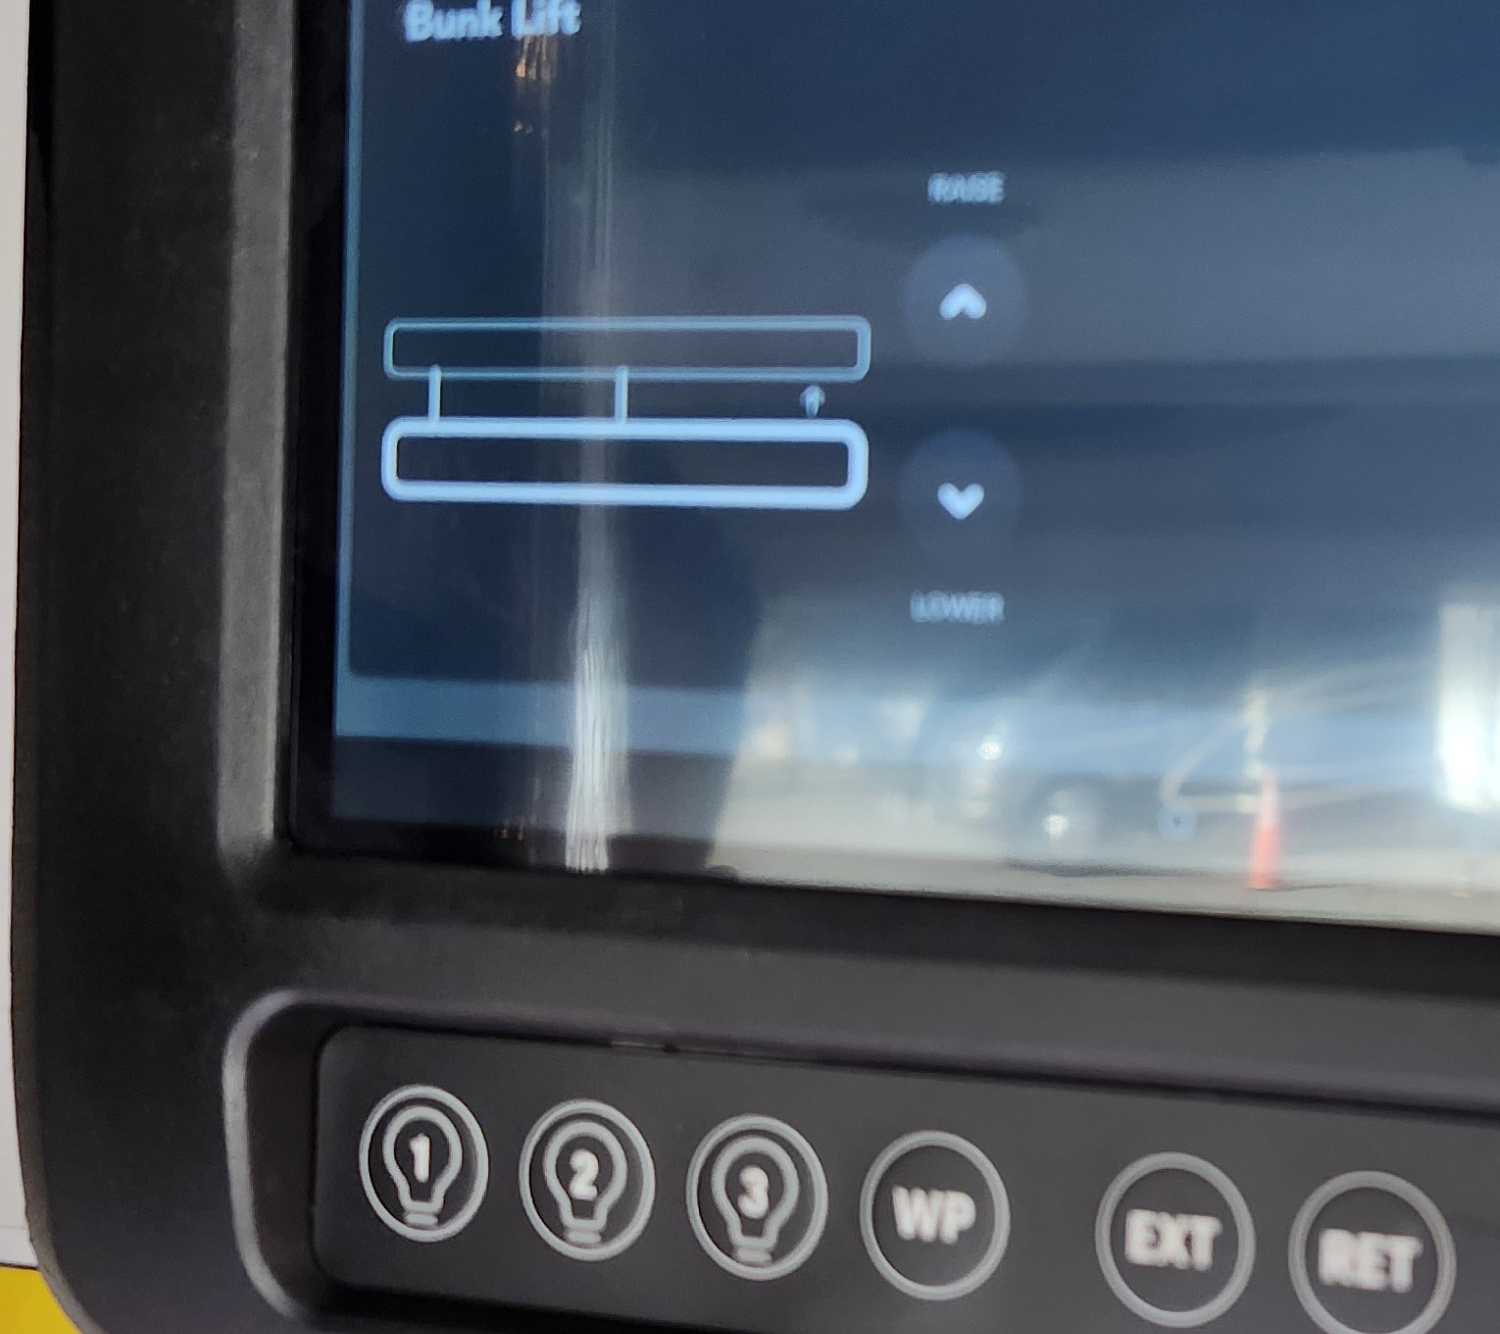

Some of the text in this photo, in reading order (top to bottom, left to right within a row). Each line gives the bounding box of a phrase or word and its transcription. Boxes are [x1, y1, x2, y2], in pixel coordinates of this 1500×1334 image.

[910, 591, 1004, 624] LOWER
[410, 1132, 430, 1182] 1
[569, 1149, 599, 1201] 2
[739, 1166, 770, 1219] 3
[892, 1185, 977, 1243] WP
[1125, 1208, 1222, 1271] EXT
[1317, 1227, 1424, 1293] RET
